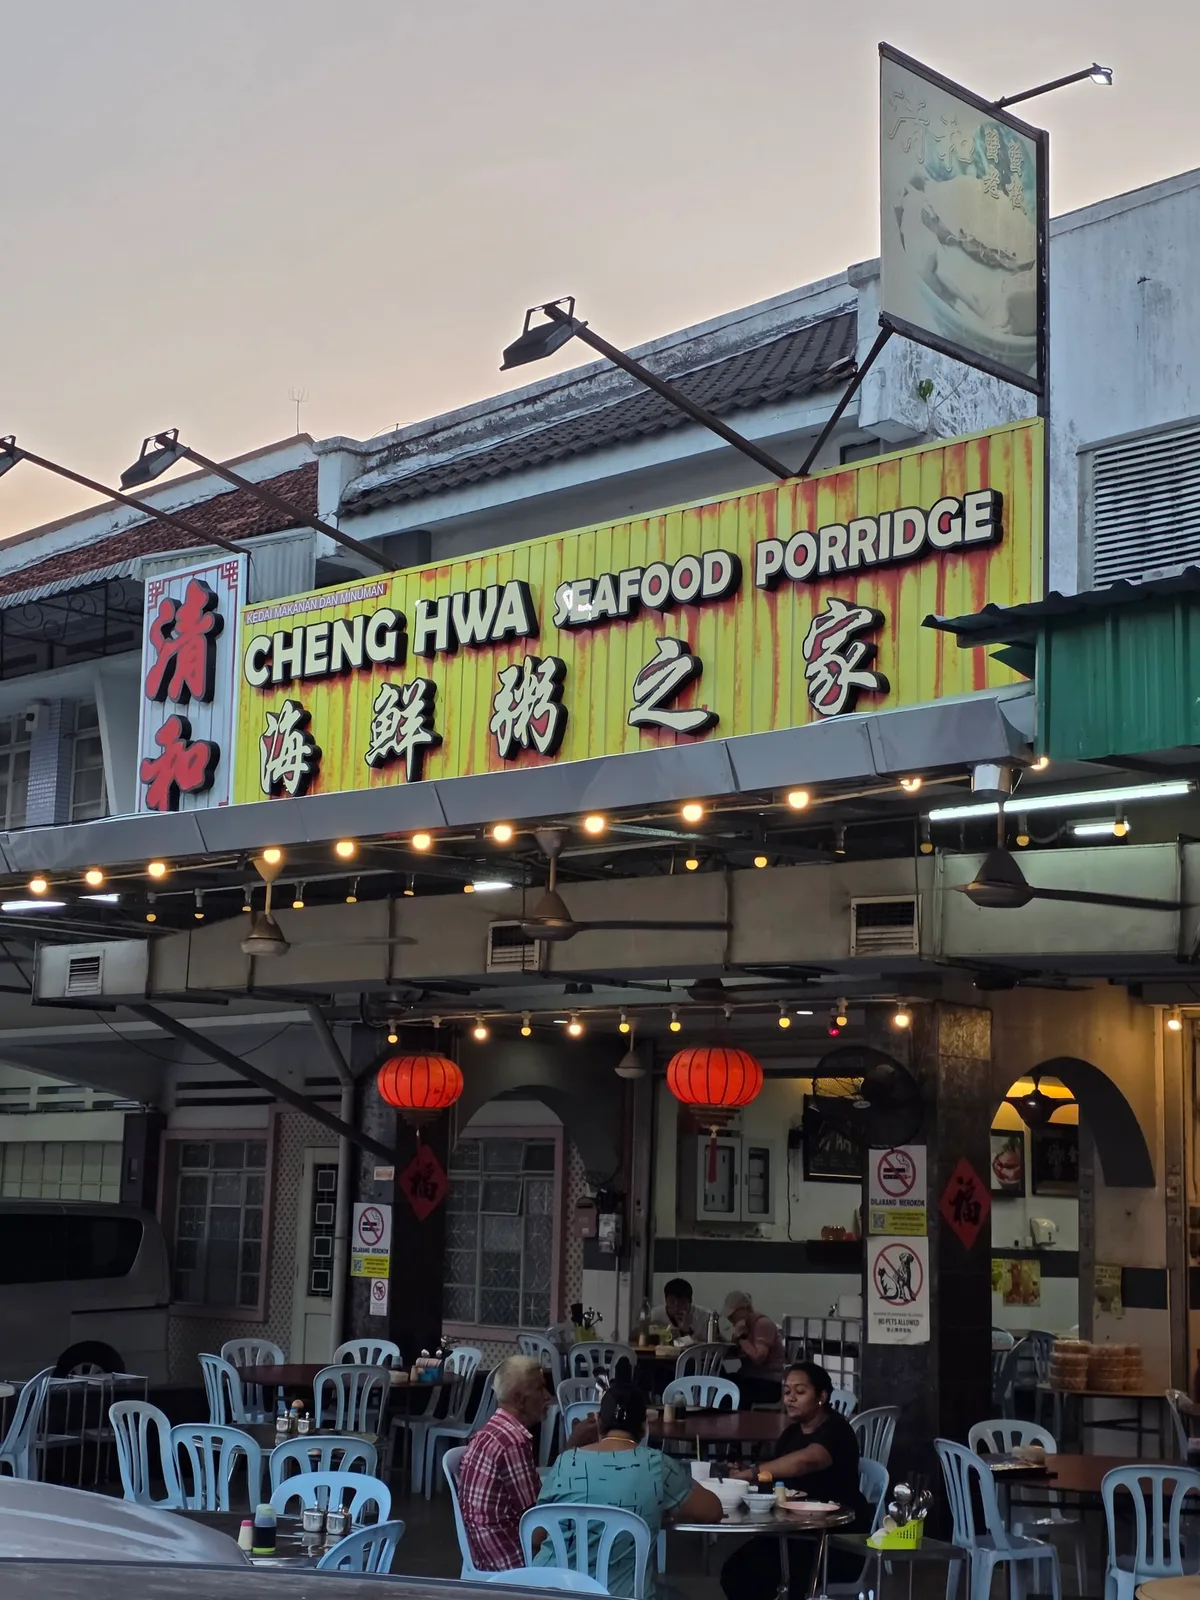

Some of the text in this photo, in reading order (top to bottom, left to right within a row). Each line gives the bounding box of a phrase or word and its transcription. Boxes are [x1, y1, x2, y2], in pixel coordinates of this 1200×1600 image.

[244, 487, 1000, 689] CHENG HWA SEAFOOD PORRIDGE
[247, 584, 385, 624] KEDAI MAKANAN DAN MINUMAN
[140, 578, 219, 812] 清和
[260, 598, 888, 797] 海鮮粥之家
[870, 1198, 926, 1207] DILARANG MEROKOK
[948, 1175, 982, 1228] 福
[886, 1318, 897, 1326] PETS
[898, 1318, 920, 1327] ALLOWED
